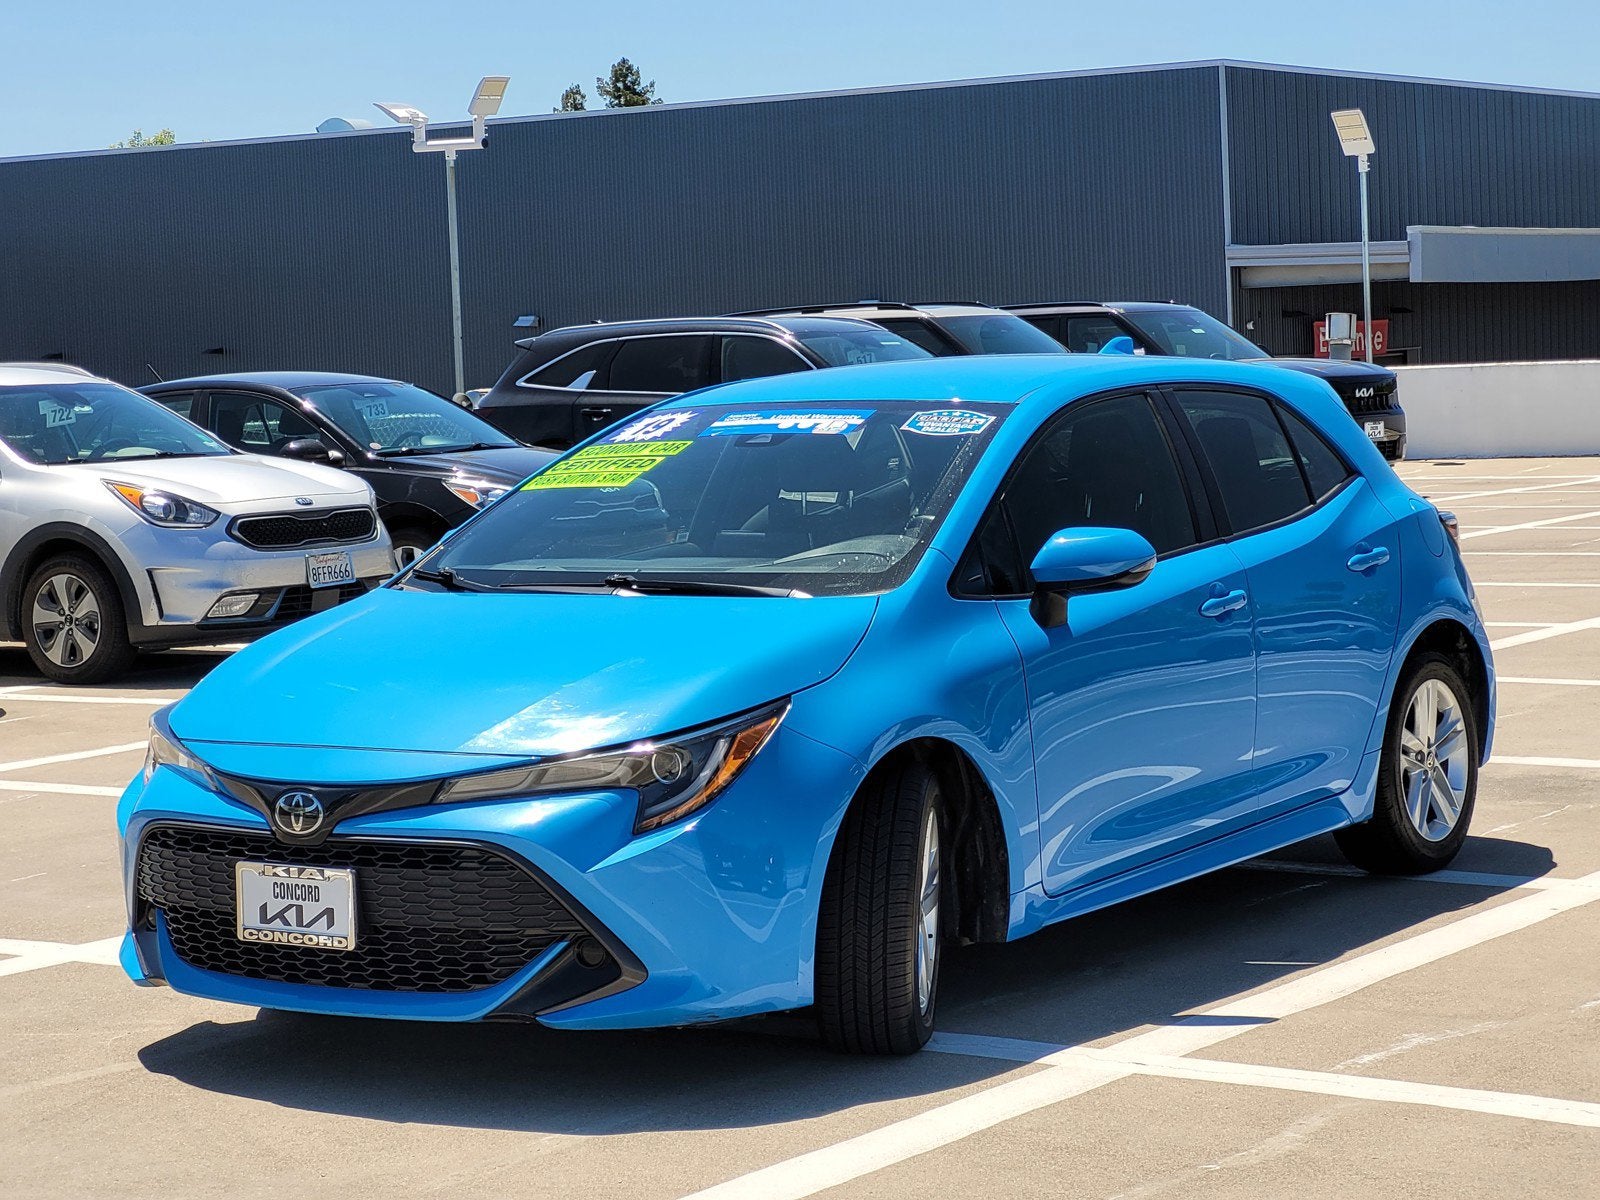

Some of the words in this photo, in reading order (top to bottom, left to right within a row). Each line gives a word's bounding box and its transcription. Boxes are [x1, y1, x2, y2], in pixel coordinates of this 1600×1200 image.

[50, 408, 73, 423] 722
[366, 403, 386, 417] 733
[916, 421, 976, 429] ADVANTAGE
[578, 444, 652, 457] ECONOMY
[649, 442, 686, 453] CAR
[551, 458, 657, 472] CERTIFIED
[533, 475, 565, 487] PUSH
[560, 474, 601, 485] BUTTON
[598, 472, 638, 484] START
[311, 563, 350, 582] 8FFR666
[263, 865, 325, 881] KIA
[272, 882, 320, 902] CONCORD
[259, 902, 335, 931] KIA
[243, 928, 348, 948] CONCORD
